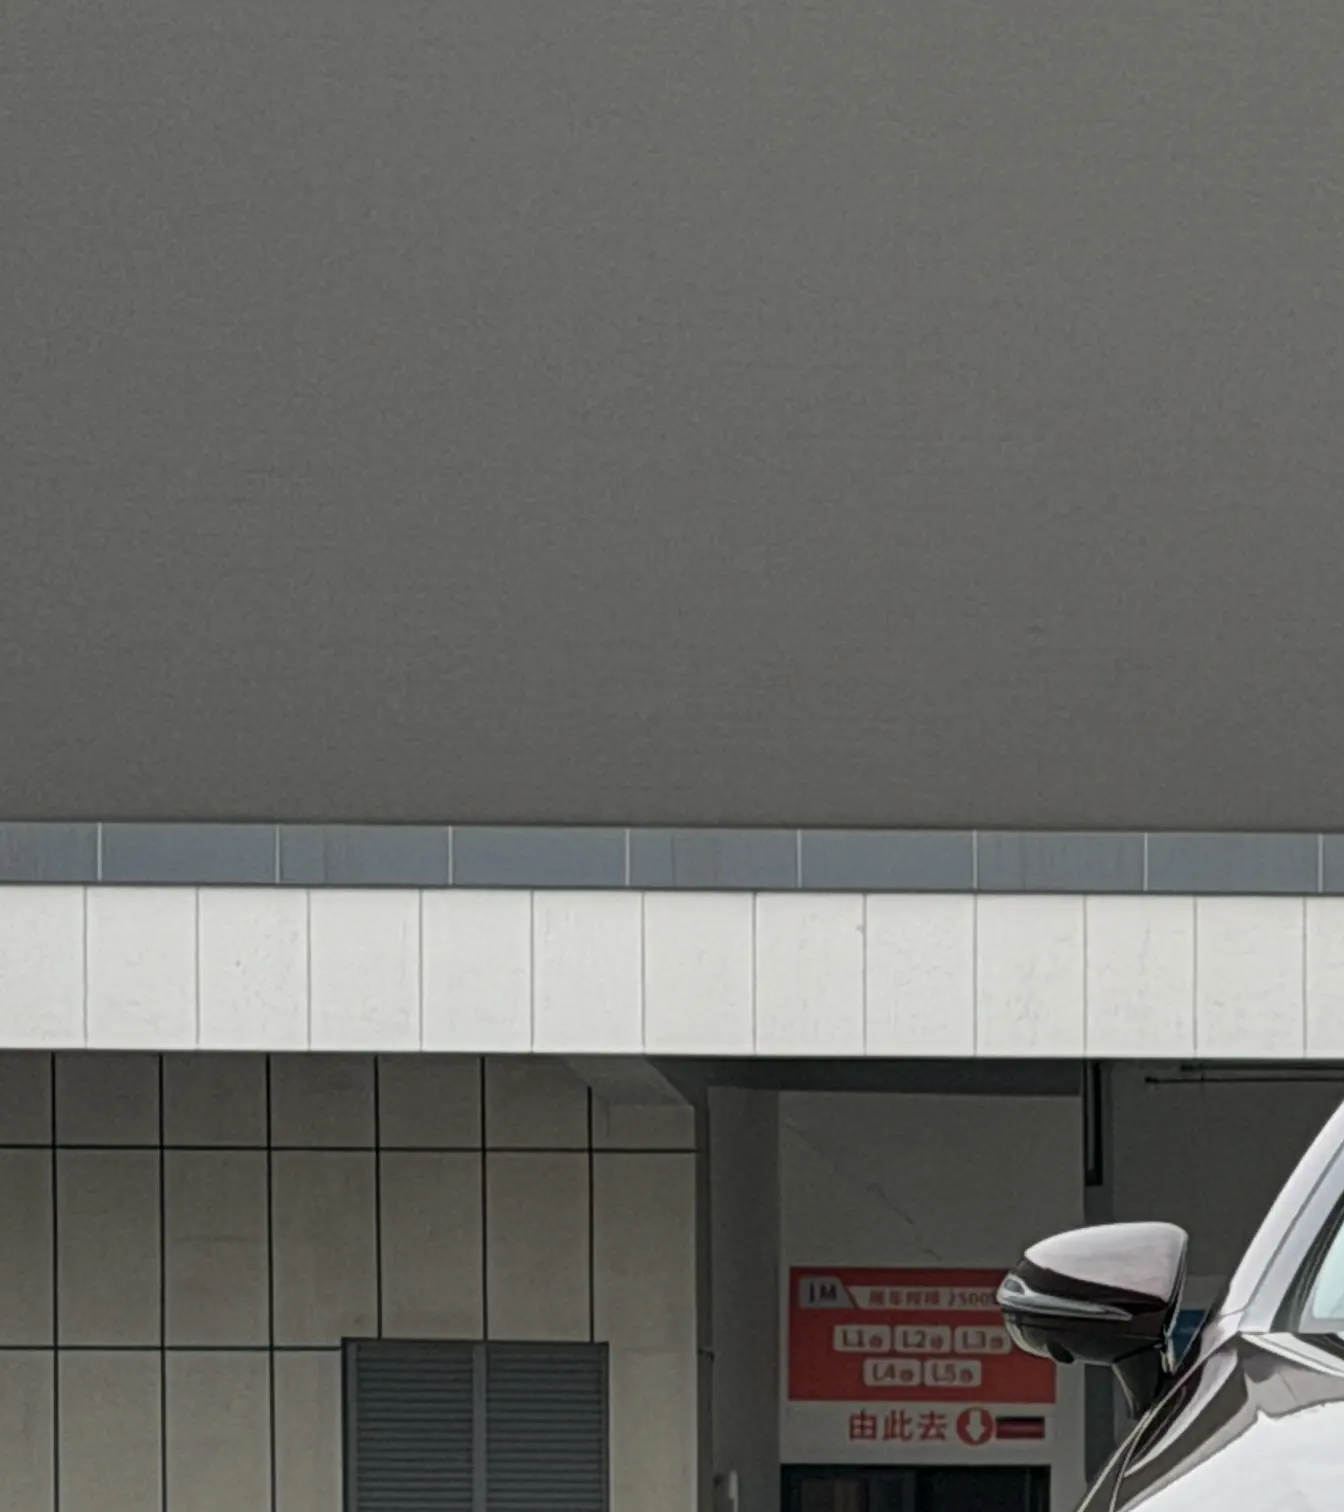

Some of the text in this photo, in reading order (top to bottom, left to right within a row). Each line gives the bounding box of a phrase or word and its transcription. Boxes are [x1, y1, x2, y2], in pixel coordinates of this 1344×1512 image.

[901, 1329, 926, 1348] L2
[849, 1408, 948, 1441] 由此去
